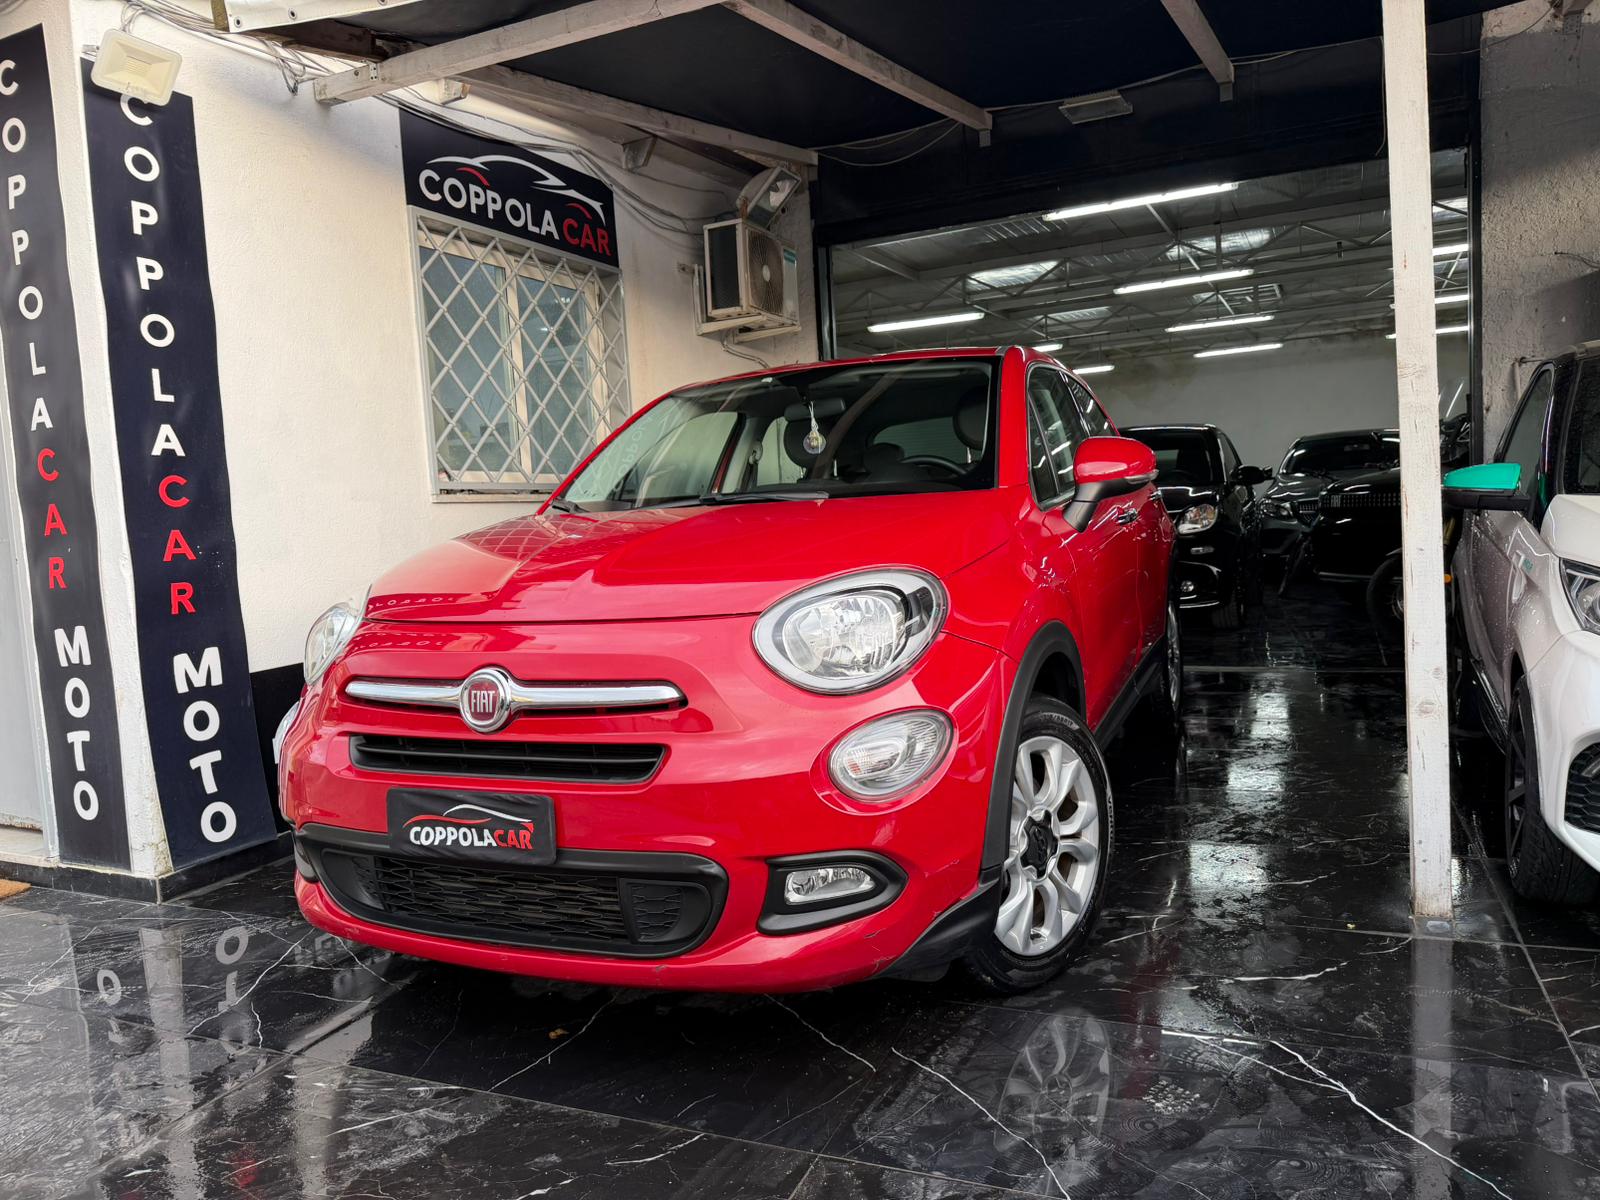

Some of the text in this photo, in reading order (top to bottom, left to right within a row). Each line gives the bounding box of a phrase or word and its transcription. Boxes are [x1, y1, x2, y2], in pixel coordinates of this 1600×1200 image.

[54, 625, 99, 821] MOTO
[173, 646, 237, 843] MOTO
[470, 690, 496, 713] FIAT
